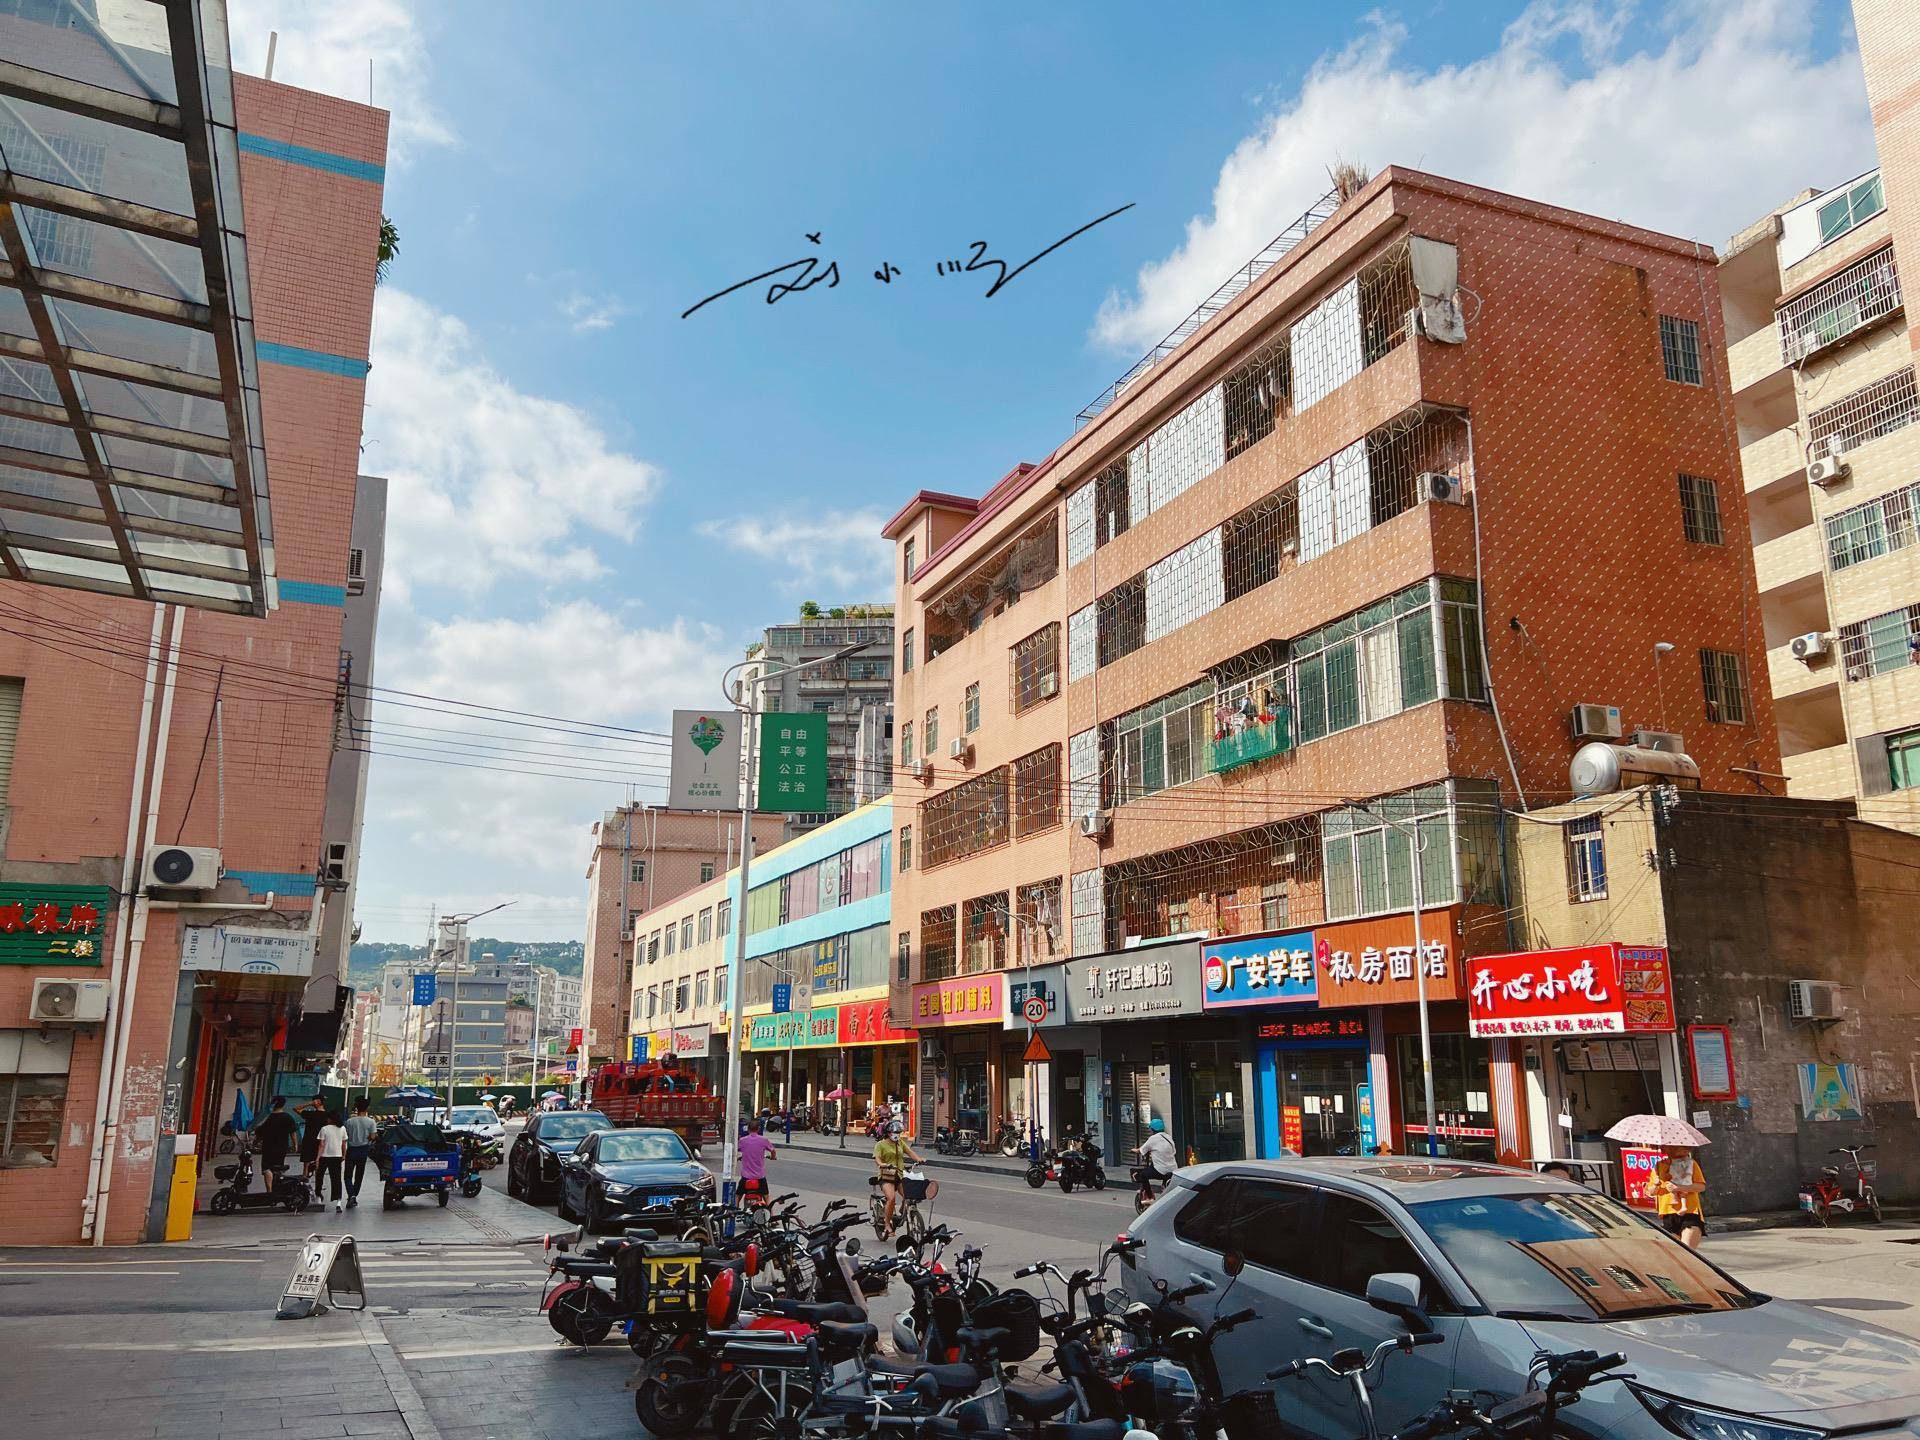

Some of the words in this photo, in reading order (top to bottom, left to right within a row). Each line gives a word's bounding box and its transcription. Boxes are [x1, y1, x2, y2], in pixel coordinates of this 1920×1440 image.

[780, 728, 807, 740] 自由
[779, 746, 806, 757] 平等
[778, 763, 806, 775] 公正
[778, 781, 805, 793] 法治
[1329, 940, 1446, 984] 私房面馆
[1226, 949, 1313, 989] 广安学车
[1471, 959, 1608, 1011] 开心小吃
[1028, 1003, 1043, 1016] 20
[427, 1054, 448, 1066] 结束
[296, 1274, 321, 1284] 禁止停车
